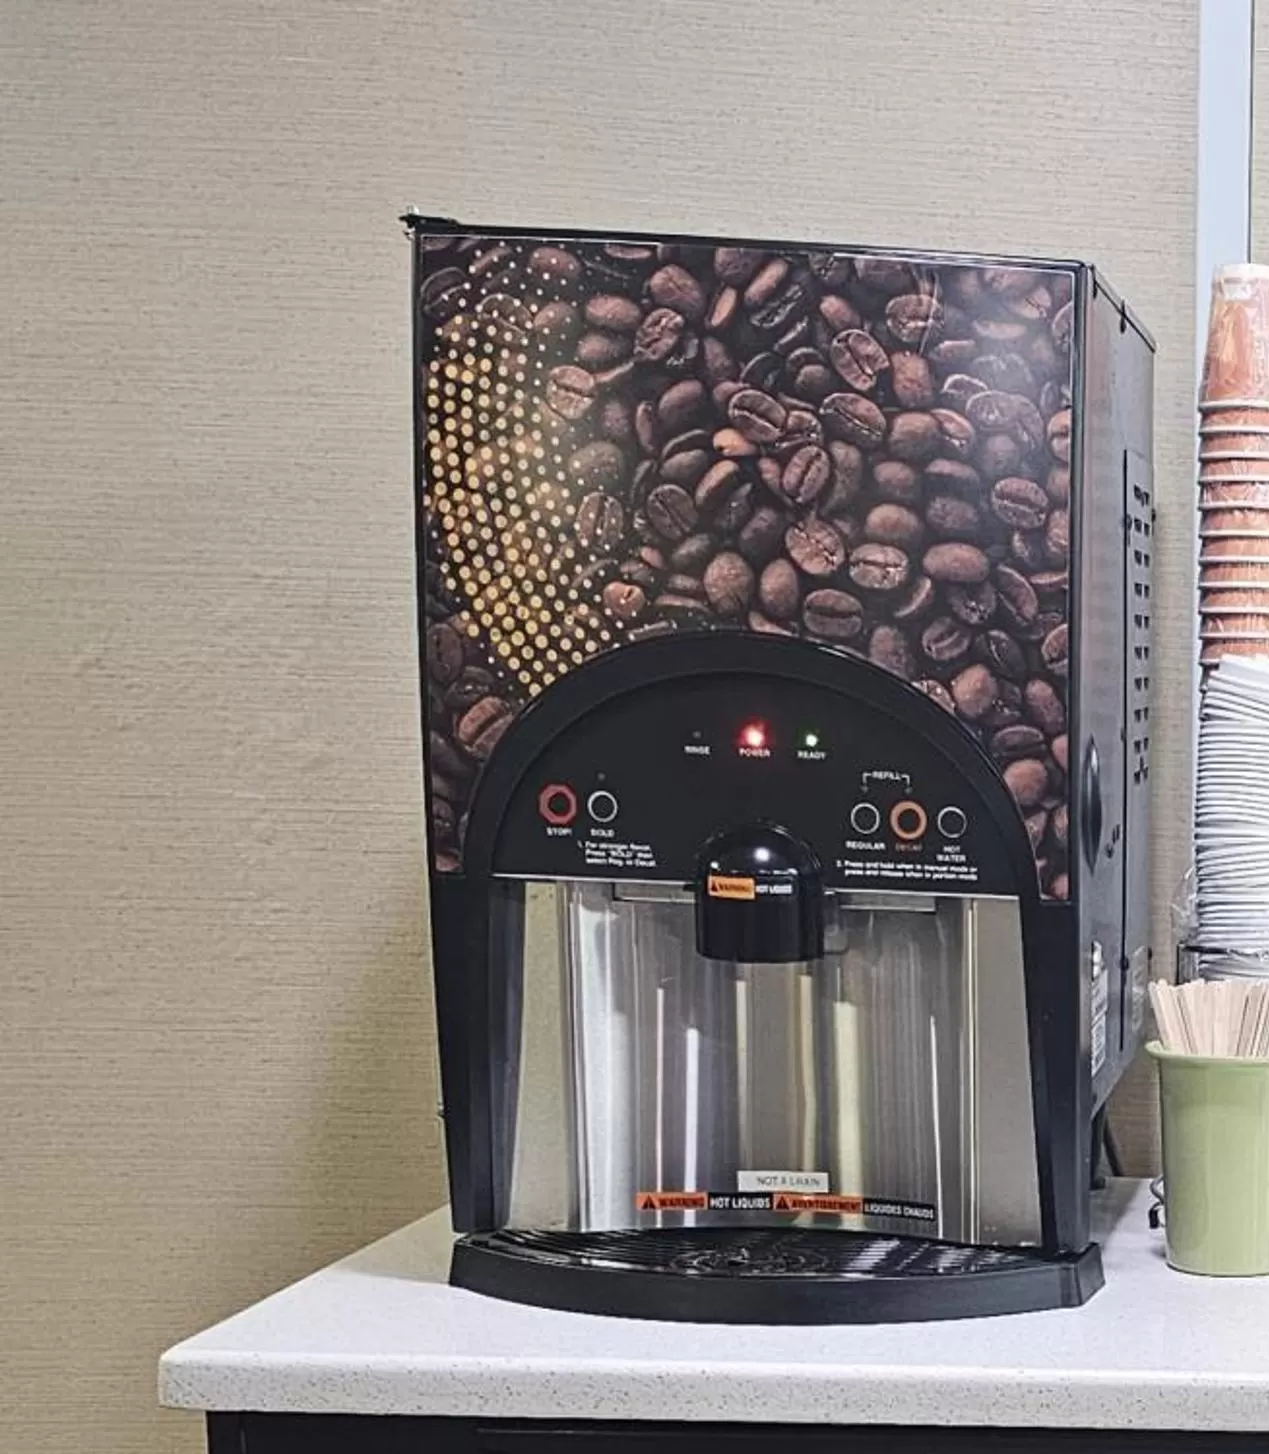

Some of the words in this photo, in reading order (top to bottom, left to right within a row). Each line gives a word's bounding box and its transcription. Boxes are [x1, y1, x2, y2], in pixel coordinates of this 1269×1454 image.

[684, 745, 710, 755] RINSE
[739, 748, 770, 757] POWER
[798, 750, 826, 760] READY
[871, 770, 901, 780] REFILL
[590, 828, 615, 838] BOLD
[845, 840, 886, 850] REGULAR
[943, 845, 961, 853] HOT
[936, 854, 967, 863] WATER
[756, 1176, 779, 1186] NOT
[658, 1197, 705, 1208] WARNING
[710, 1197, 729, 1209] HOT
[732, 1197, 771, 1209] LIQUIDS
[864, 1203, 901, 1216] LIQUIDES
[903, 1205, 935, 1220] CHAUDS
